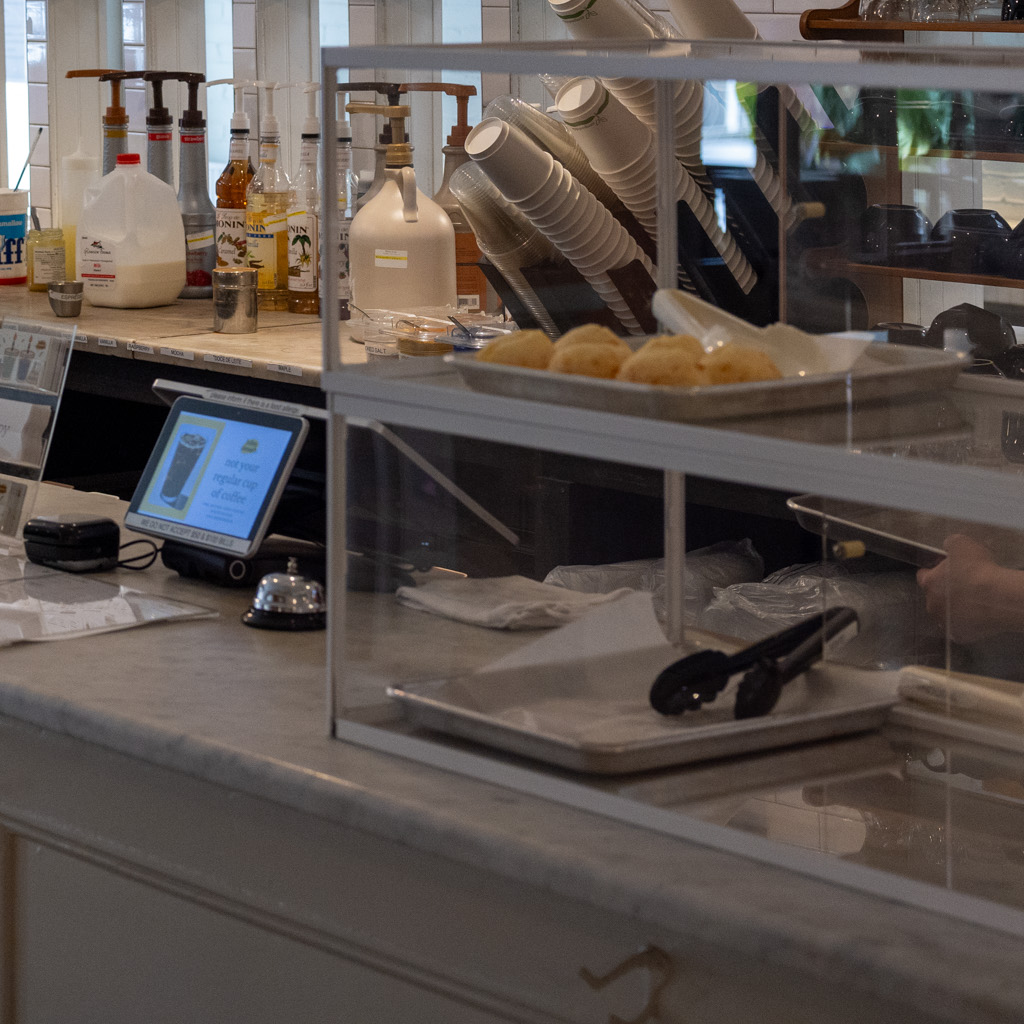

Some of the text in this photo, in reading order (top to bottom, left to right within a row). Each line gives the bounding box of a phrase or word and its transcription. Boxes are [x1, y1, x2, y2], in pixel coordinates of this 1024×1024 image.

[128, 344, 151, 353] RASPBERRY
[170, 349, 184, 357] MOCHA
[375, 346, 387, 354] SALT
[224, 459, 261, 473] not your
[212, 473, 259, 492] regular cup
[210, 487, 247, 504] of coffee
